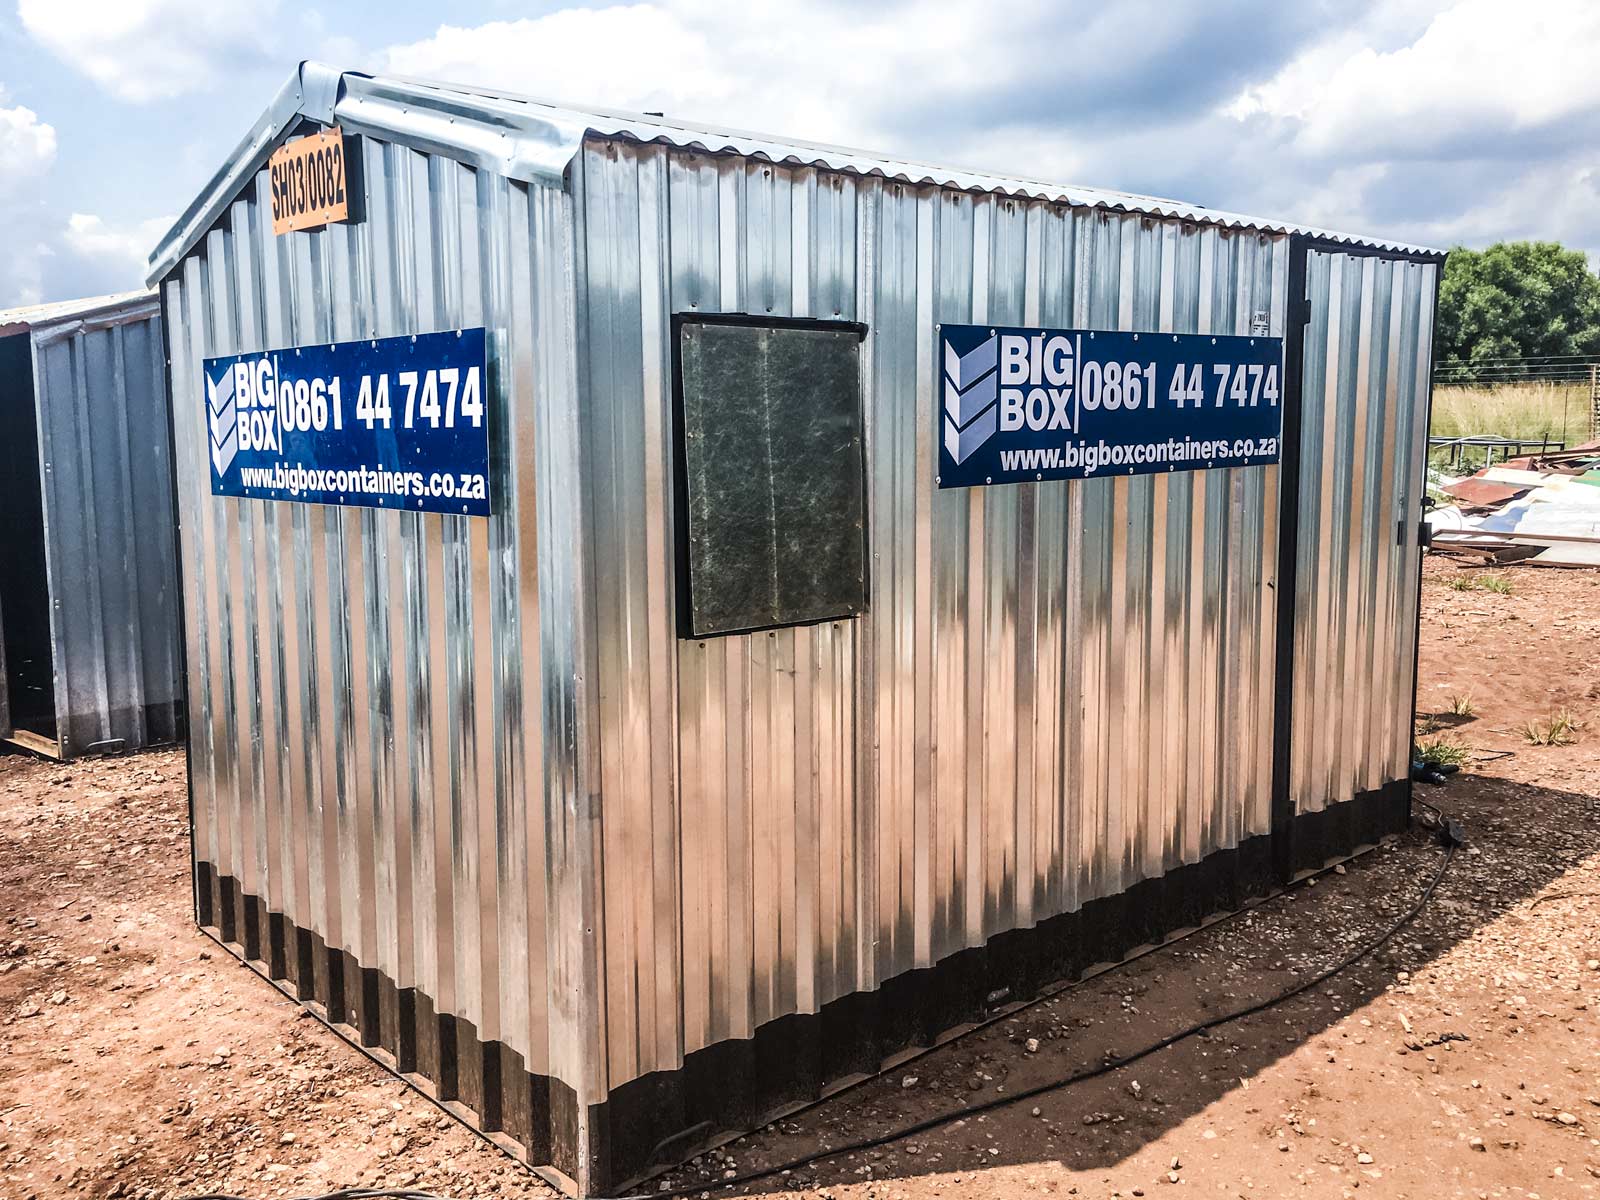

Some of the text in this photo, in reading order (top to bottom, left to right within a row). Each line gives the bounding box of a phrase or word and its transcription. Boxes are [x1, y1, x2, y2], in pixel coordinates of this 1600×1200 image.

[271, 143, 345, 221] SH03/0082
[234, 358, 275, 409] BIG
[1000, 335, 1074, 386] BIG
[279, 366, 484, 432] 0861 44 7474
[1000, 388, 1072, 432] BOX
[1081, 361, 1279, 411] 0861 44 7474
[236, 408, 278, 451] BOX
[999, 436, 1277, 472] www.bigboxcontainers.co.za
[240, 462, 486, 499] www.bigboxcontainers.co.za
